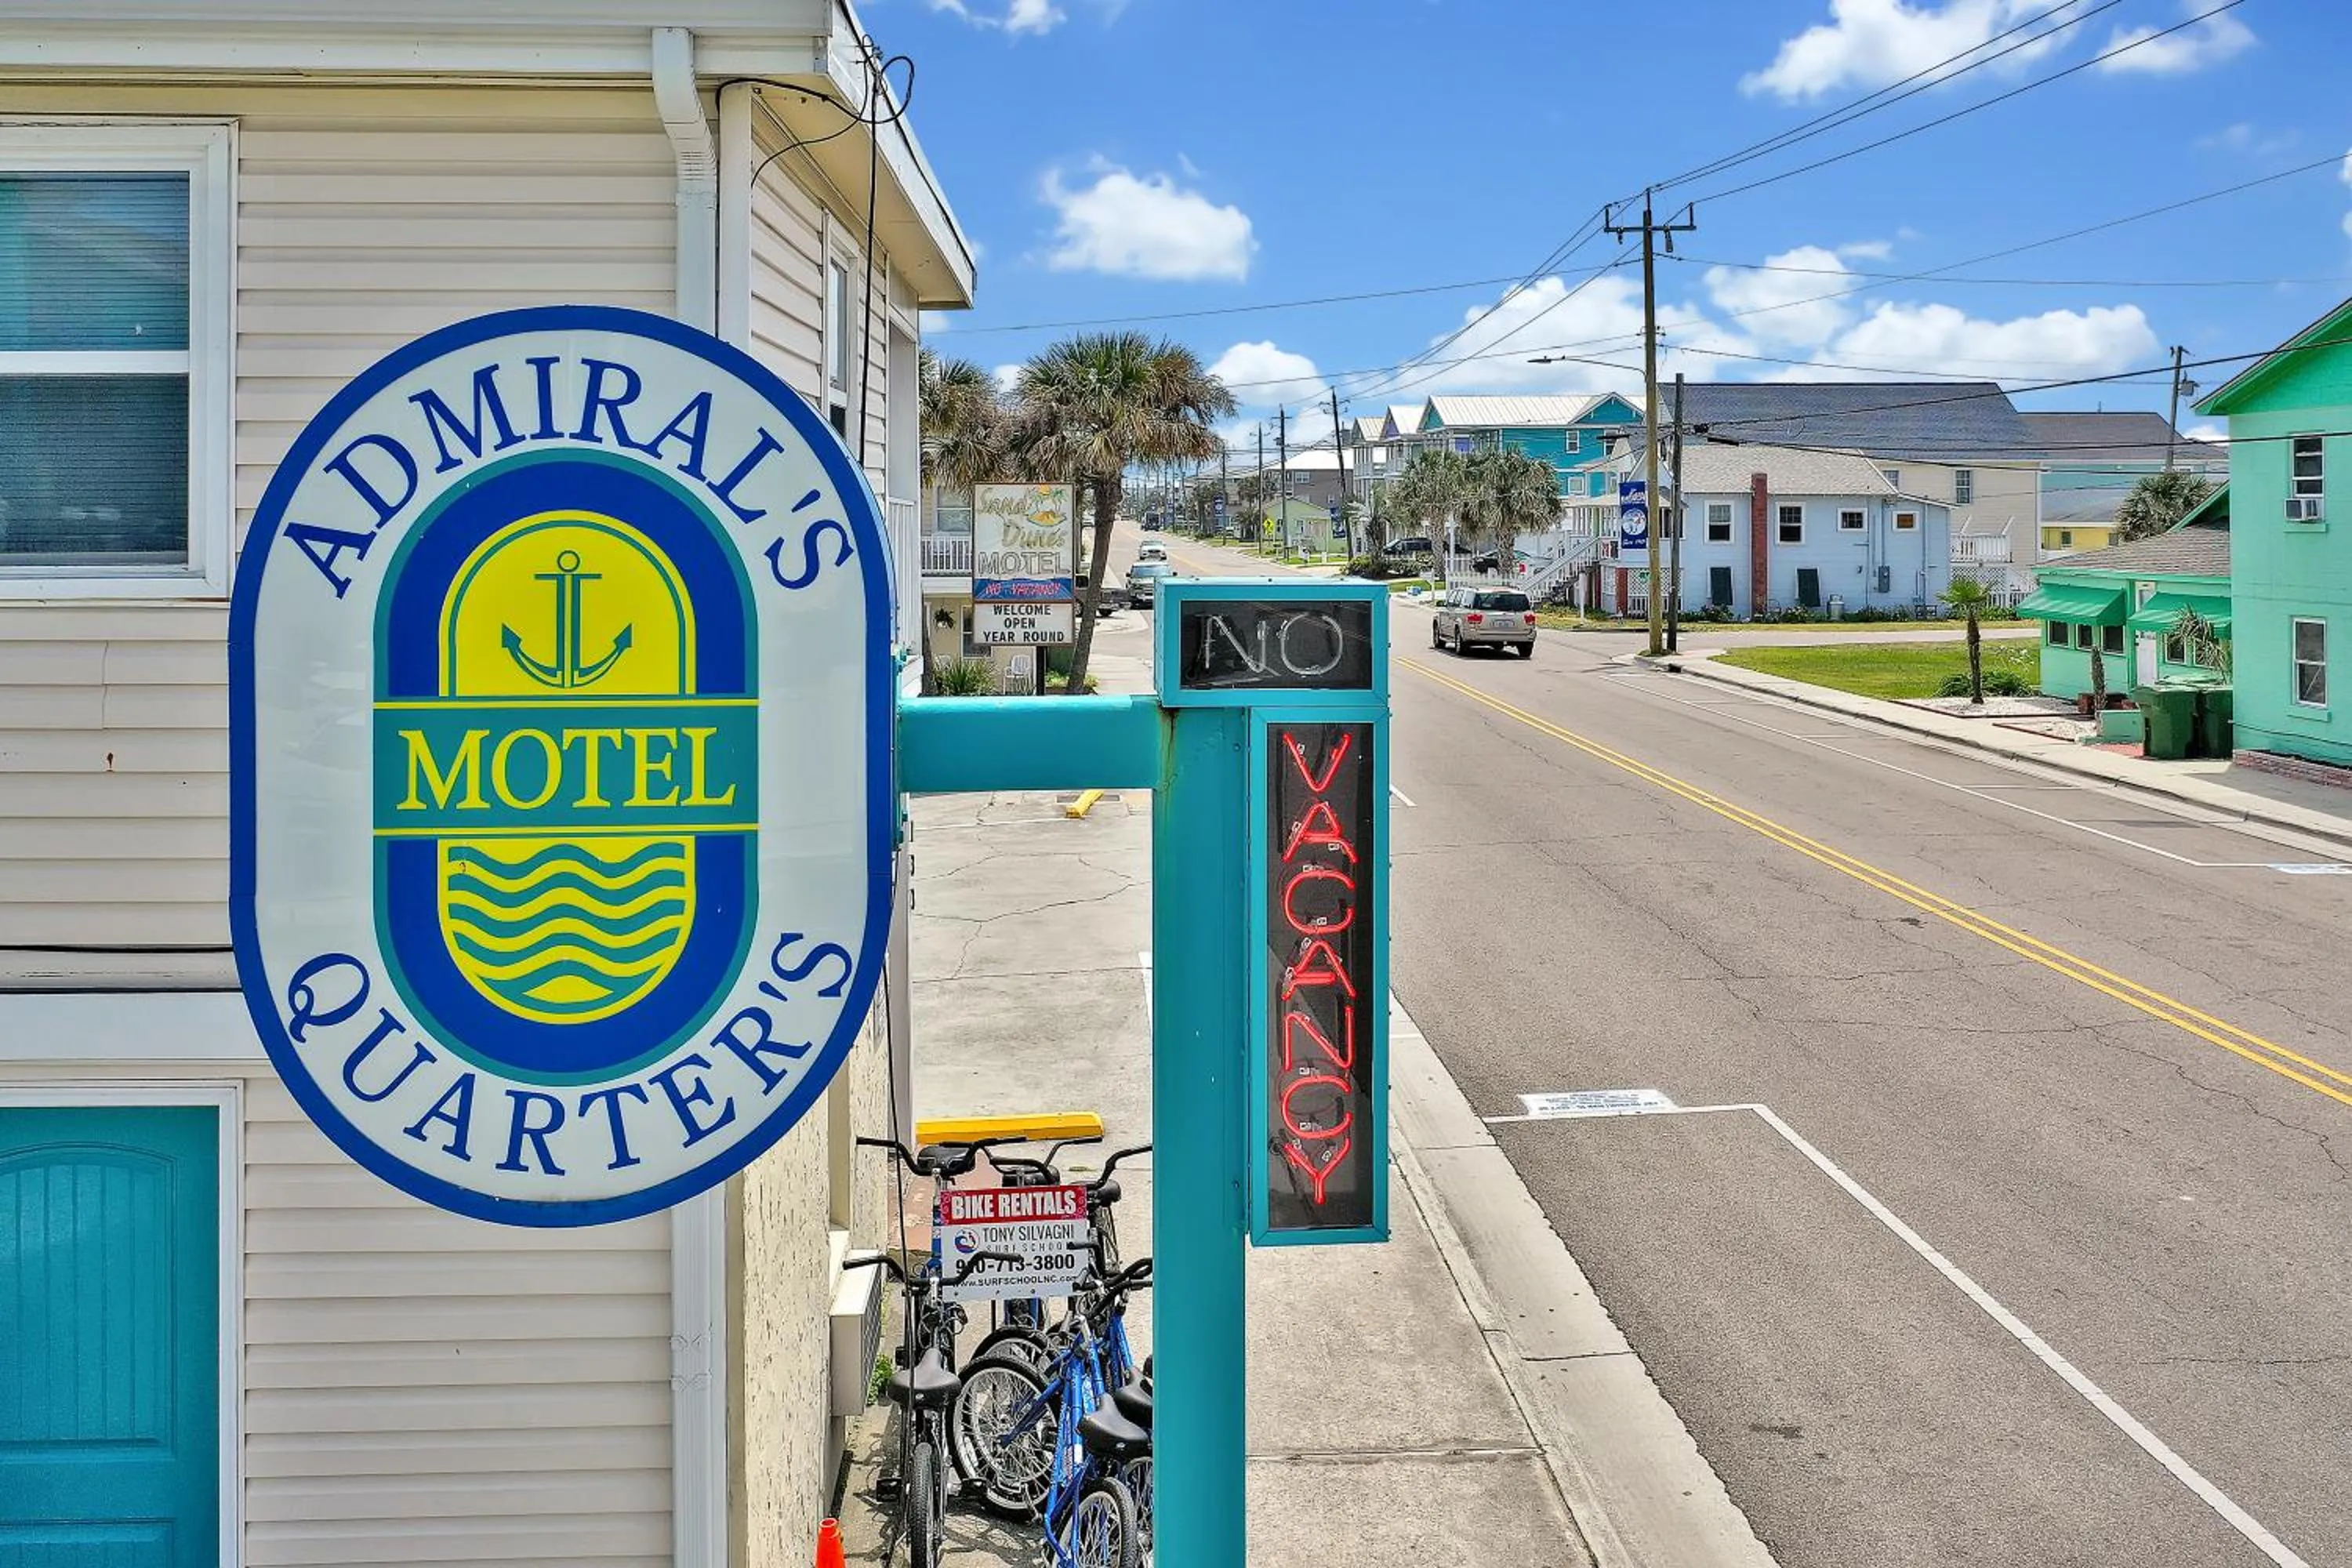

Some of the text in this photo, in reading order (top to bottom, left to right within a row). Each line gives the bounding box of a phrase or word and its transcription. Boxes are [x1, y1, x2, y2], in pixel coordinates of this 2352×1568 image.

[283, 355, 855, 600] ADMIRAL'S
[978, 551, 1072, 575] MOTEL
[993, 604, 1051, 615] WELCOME
[1004, 617, 1036, 629] OPEN
[983, 631, 1065, 642] YEAR ROUND
[1203, 612, 1344, 677] NO
[397, 726, 737, 811] MOTEL
[1283, 732, 1358, 1206] VACANCY
[288, 931, 852, 1177] QUARTER'S
[951, 1189, 1076, 1220] BIKE RENTALS
[982, 1225, 1074, 1243] TONY SILVAGNI
[985, 1242, 1063, 1253] SURF SCHOO
[956, 1254, 1075, 1275] 90-713-3800
